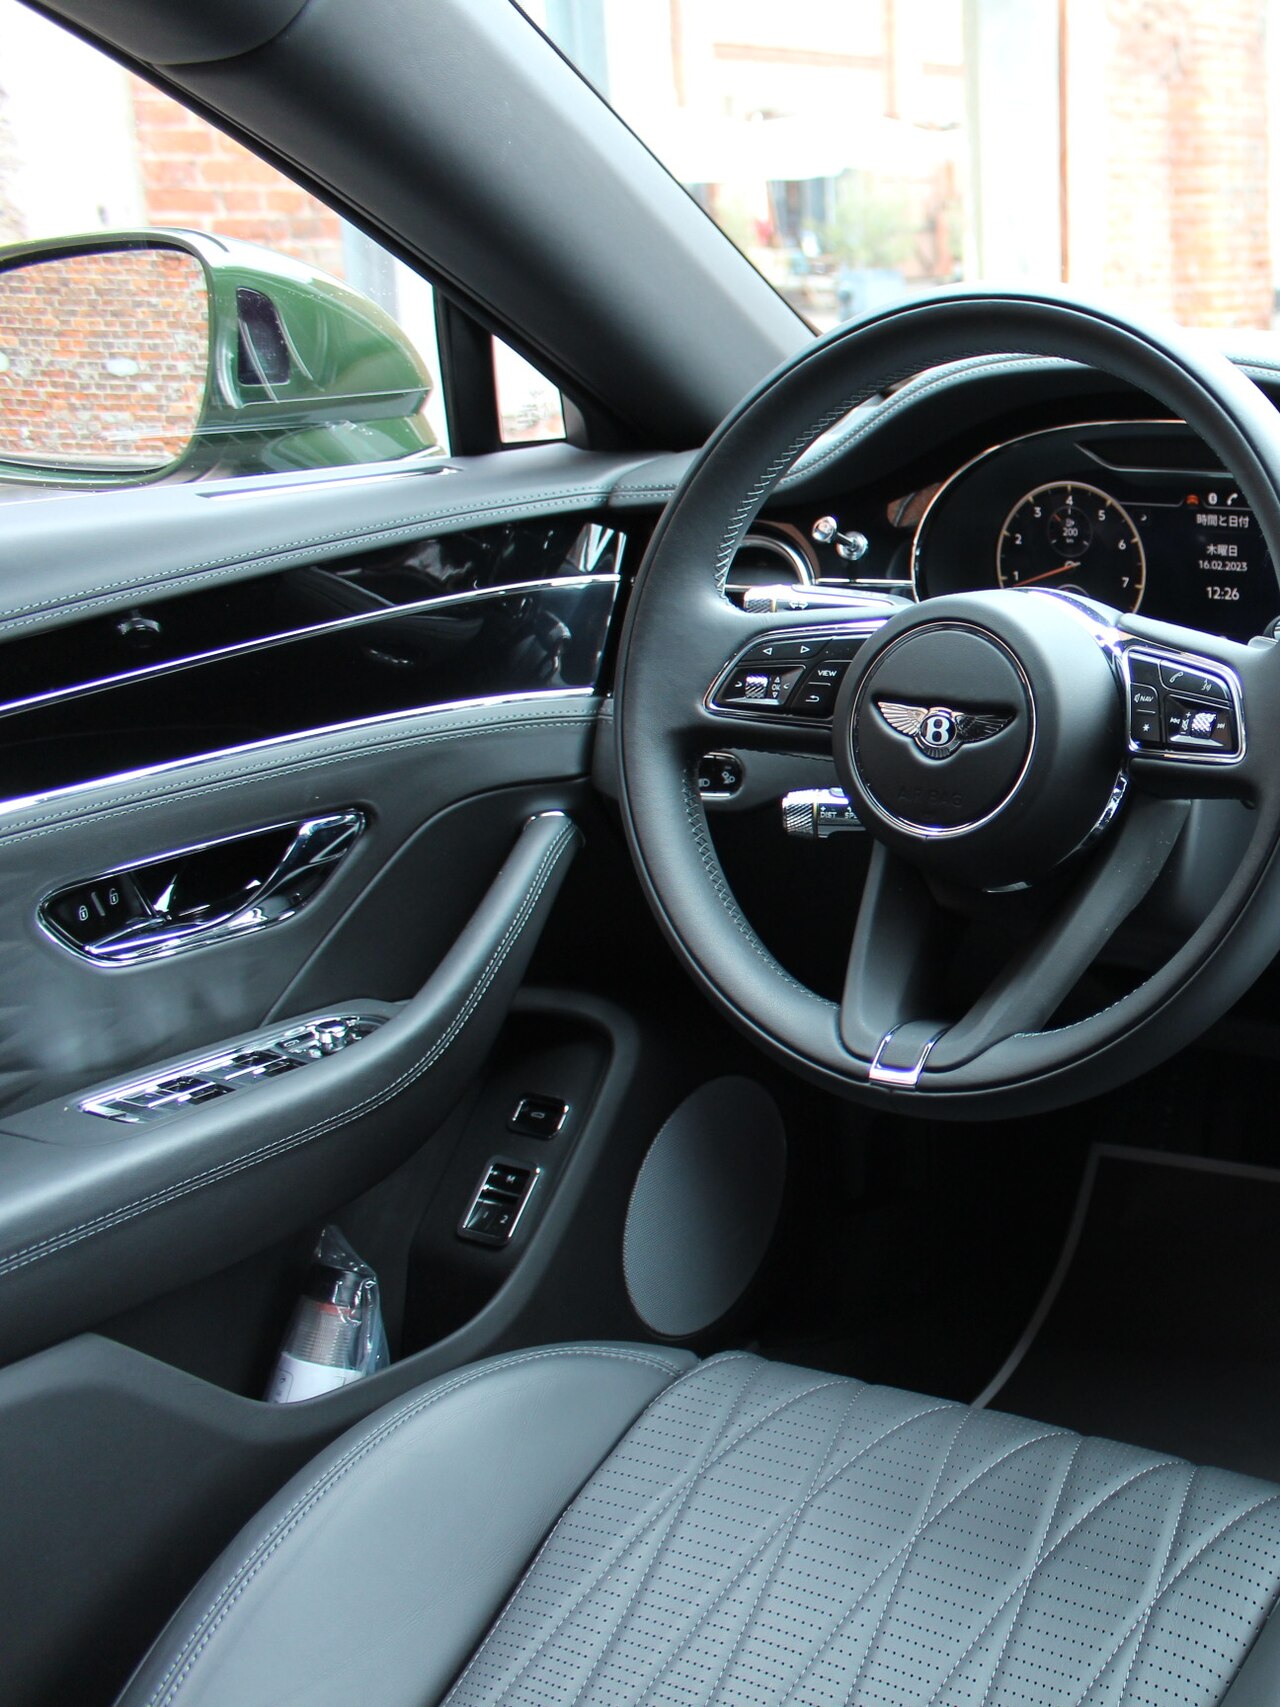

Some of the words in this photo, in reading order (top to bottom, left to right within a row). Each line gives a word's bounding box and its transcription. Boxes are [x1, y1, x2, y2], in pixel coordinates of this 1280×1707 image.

[1034, 507, 1042, 518] 3
[1098, 510, 1106, 521] 5
[1196, 514, 1249, 528] 時間と日付
[1063, 527, 1078, 537] 200
[1118, 539, 1126, 550] 6
[1206, 544, 1237, 557] 木曜日
[1198, 560, 1248, 572] 16.02.2023
[1206, 586, 1240, 600] 12:26
[1140, 693, 1154, 702] NAV
[927, 718, 949, 744] B
[500, 1215, 508, 1224] 2
